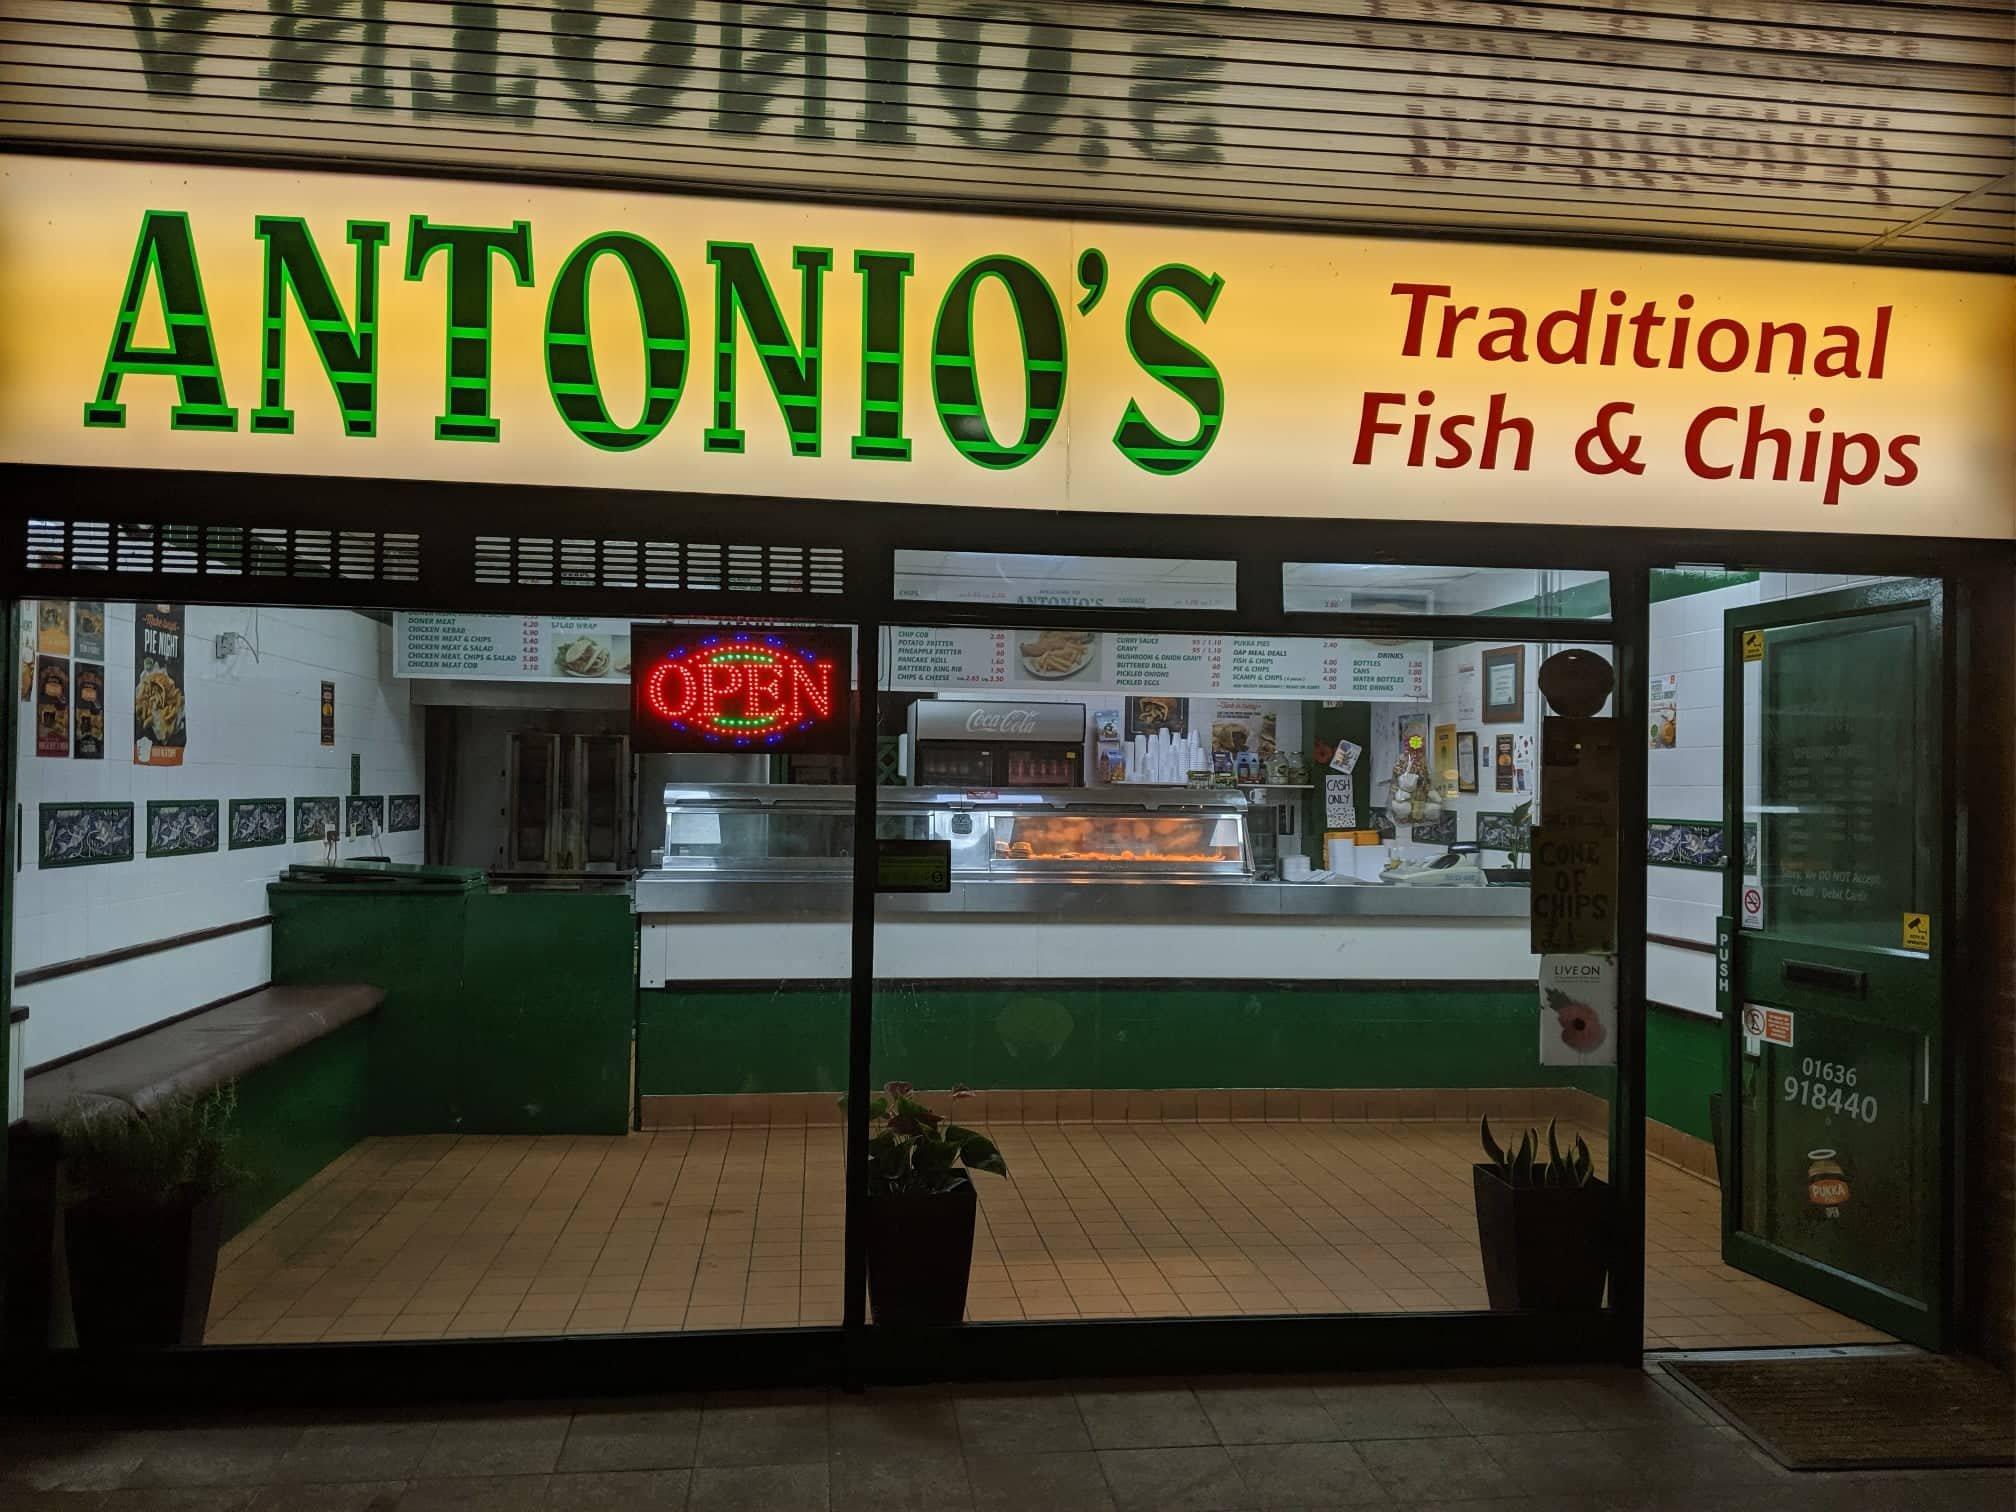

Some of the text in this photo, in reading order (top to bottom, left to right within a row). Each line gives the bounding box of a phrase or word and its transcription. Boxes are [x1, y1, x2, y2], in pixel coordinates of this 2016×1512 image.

[84, 210, 1226, 475] ANTONIO'S
[1390, 282, 1894, 380] Traditional
[1352, 390, 1920, 506] Fish & Chips
[144, 628, 179, 658] PIE NIGHT
[649, 663, 831, 719] OPEN
[1326, 779, 1350, 791] CASH
[1327, 793, 1350, 805] ONLY
[1540, 841, 1600, 866] CONE
[1555, 869, 1586, 894] OF
[1818, 870, 1830, 881] DO
[1832, 870, 1852, 882] NOT
[1535, 893, 1609, 920] CHIPS
[1822, 887, 1843, 900] Debit
[1554, 965, 1600, 976] LIVE ON
[1719, 933, 1729, 992] PUSH
[1801, 1057, 1857, 1087] 01636
[1784, 1076, 1878, 1123] 918440
[1812, 1183, 1845, 1197] PUKKA
